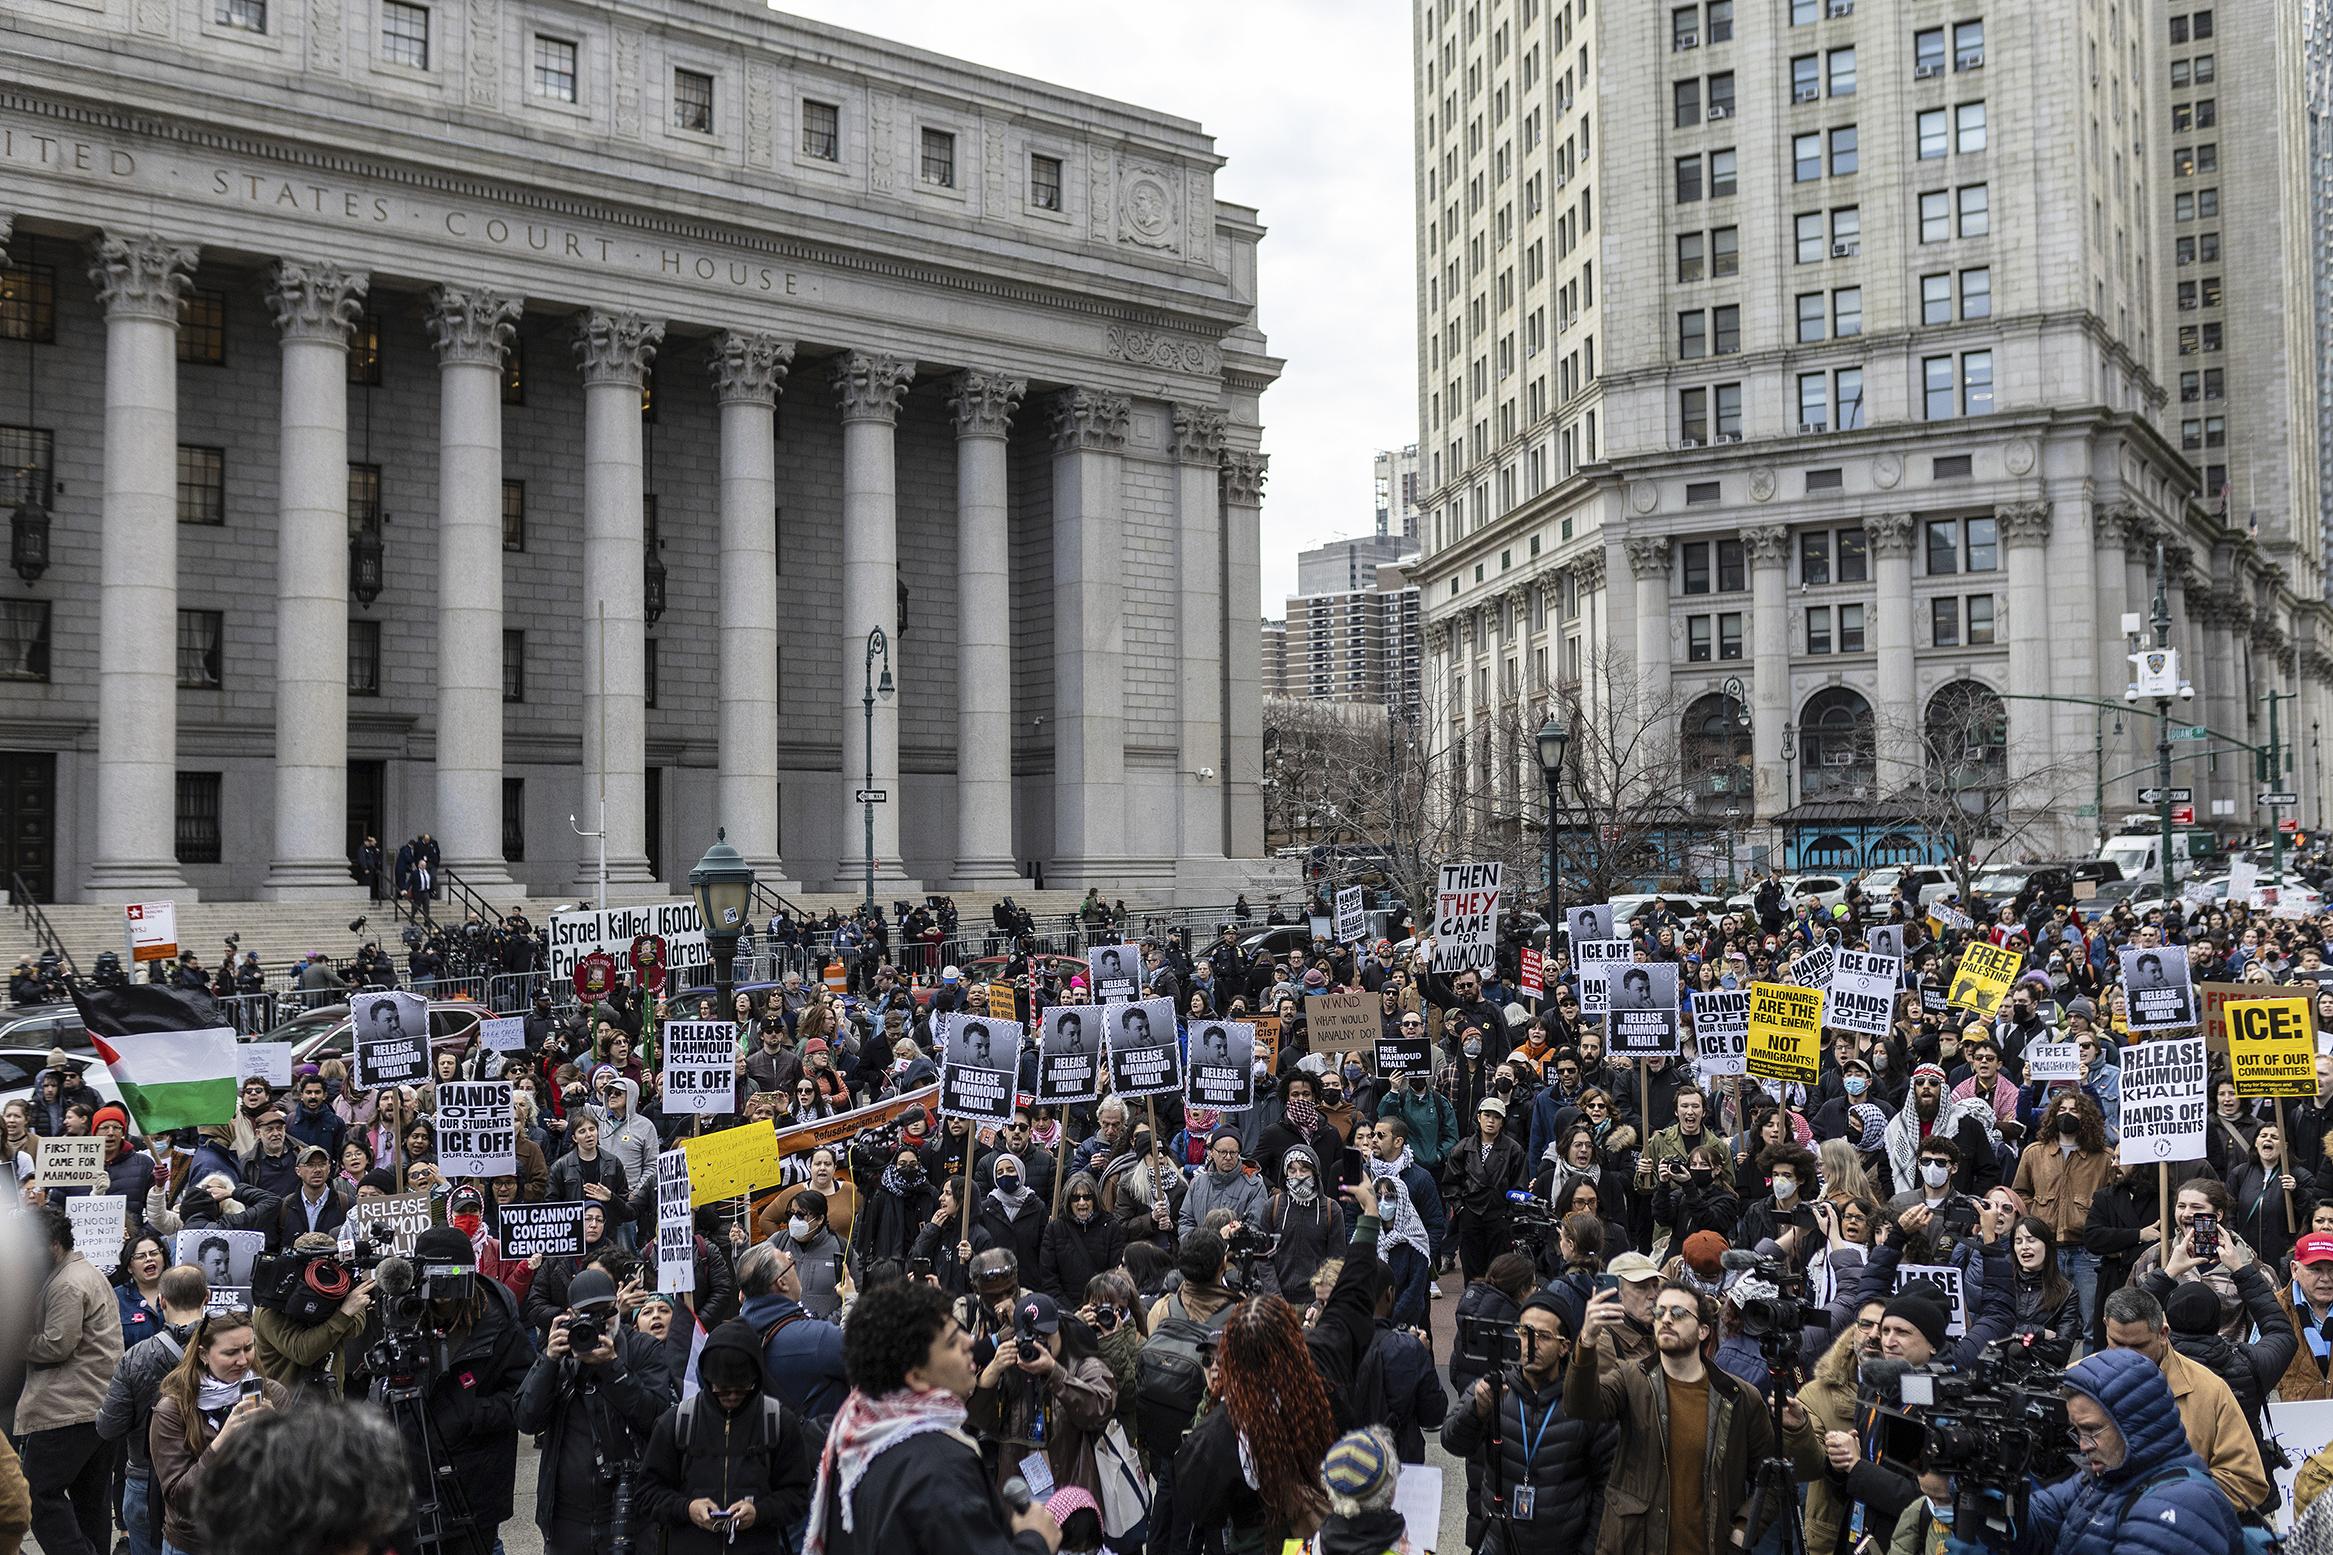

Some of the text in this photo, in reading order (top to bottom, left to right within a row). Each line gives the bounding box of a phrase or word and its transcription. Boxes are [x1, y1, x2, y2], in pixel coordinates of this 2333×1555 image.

[212, 169, 389, 222] STATES
[445, 211, 614, 262] COURT
[661, 250, 797, 296] HOUSE
[1440, 891, 1500, 917] THEY
[550, 904, 703, 946] Israel Killed 16,000
[1440, 915, 1490, 936] CAME
[1457, 932, 1478, 944] FOR
[1433, 943, 1495, 972] MAHMOUD
[1582, 943, 1630, 958] ICE OFF
[1791, 946, 1833, 980] HANDS
[1839, 952, 1895, 975] ICE OFF
[1967, 943, 2016, 974] FREE
[1798, 963, 1835, 987] OFF
[1853, 971, 1893, 981] CAMPUSES
[1959, 961, 2013, 984] PALESTINE
[1102, 978, 1130, 988] RELEASE
[1098, 986, 1135, 996] MAHMOUD
[1756, 987, 1819, 1006] BILLIONAIRES
[1923, 990, 1940, 998] FREE
[2139, 989, 2177, 1001] RELEASE
[1105, 995, 1128, 1003] KHALIL
[1694, 992, 1752, 1014] HANDS
[1834, 991, 1889, 1014] HANDS
[1924, 996, 1948, 1004] MAHM
[2135, 998, 2184, 1011] MAHMOUD
[1585, 1003, 1598, 1011] OUR
[1757, 999, 1815, 1020] ARE THE
[1315, 1014, 1369, 1026] WHAT WOULD
[1623, 1012, 1663, 1024] RELEASE
[1698, 1011, 1750, 1023] OFF
[1834, 1008, 1887, 1022] OFF
[2145, 1009, 2176, 1021] KHALIL
[1617, 1023, 1669, 1035] MAHMOUD
[1698, 1023, 1716, 1033] OUR
[1753, 1012, 1817, 1034] REAL ENEMY,
[1831, 1016, 1886, 1032] OUR STUDENTS
[2232, 1007, 2303, 1041] ICE:
[670, 1024, 733, 1042] RELEASE
[1318, 1028, 1376, 1042] NAVALNY DO?
[1627, 1034, 1660, 1047] KHALIL
[373, 1041, 414, 1057] RELEASE
[669, 1041, 733, 1054] MAHMOUD
[1379, 1046, 1397, 1054] FREE
[1700, 1036, 1728, 1054] ICE
[1768, 1034, 1801, 1053] NOT
[670, 1054, 733, 1064] KHALIL
[1125, 1049, 1165, 1064] RELEASE
[1380, 1053, 1422, 1061] MAHMOUD
[1751, 1047, 1815, 1067] IMMIGRANTS!
[2036, 1046, 2072, 1057] FREE
[2123, 1041, 2203, 1072] RELEASE
[367, 1051, 422, 1070] MAHMOUD
[1054, 1056, 1088, 1069] RELEASE
[2236, 1053, 2310, 1066] OUT OF OUR
[377, 1066, 413, 1080] KHALIL
[1048, 1067, 1091, 1082] MAHMOUD
[1120, 1060, 1170, 1076] MAHMOUD
[1201, 1067, 1239, 1080] RELEASE
[2238, 1066, 2311, 1077] COMMUNITIES!
[669, 1070, 732, 1089] ICE OFF
[958, 1069, 1000, 1086] RELEASE
[1131, 1073, 1163, 1086] KHALIL
[2122, 1064, 2204, 1089] MAHMOUD
[951, 1081, 1006, 1100] MAHMOUD
[1055, 1081, 1083, 1093] KHALIL
[1195, 1078, 1244, 1091] MAHMOUD
[440, 1084, 511, 1106] HANDS
[1204, 1089, 1236, 1101] KHALIL
[2123, 1083, 2205, 1103] KHALIL
[960, 1095, 994, 1111] KHALIL
[441, 1107, 510, 1119] OFF
[2123, 1102, 2204, 1126] HANDS OFF
[439, 1117, 512, 1129] OUR STUDENTS
[813, 1111, 887, 1142] RefuseFascism.org
[2123, 1120, 2204, 1139] OUR STUDENTS
[44, 1142, 102, 1154] FIRST THEY
[441, 1132, 513, 1153] ICE OFF
[48, 1157, 97, 1168] CAME FOR
[462, 1151, 513, 1159] CAMPUSES
[70, 1200, 124, 1213] OPPOSING
[361, 1197, 429, 1219] RELEASE
[501, 1206, 583, 1226] YOU CANNOT
[85, 1226, 116, 1236] IS NOT
[360, 1214, 432, 1239] MMOUD
[512, 1223, 573, 1240] COVERUP
[75, 1237, 122, 1247] UPPORTING
[508, 1238, 578, 1256] GENOCIDE
